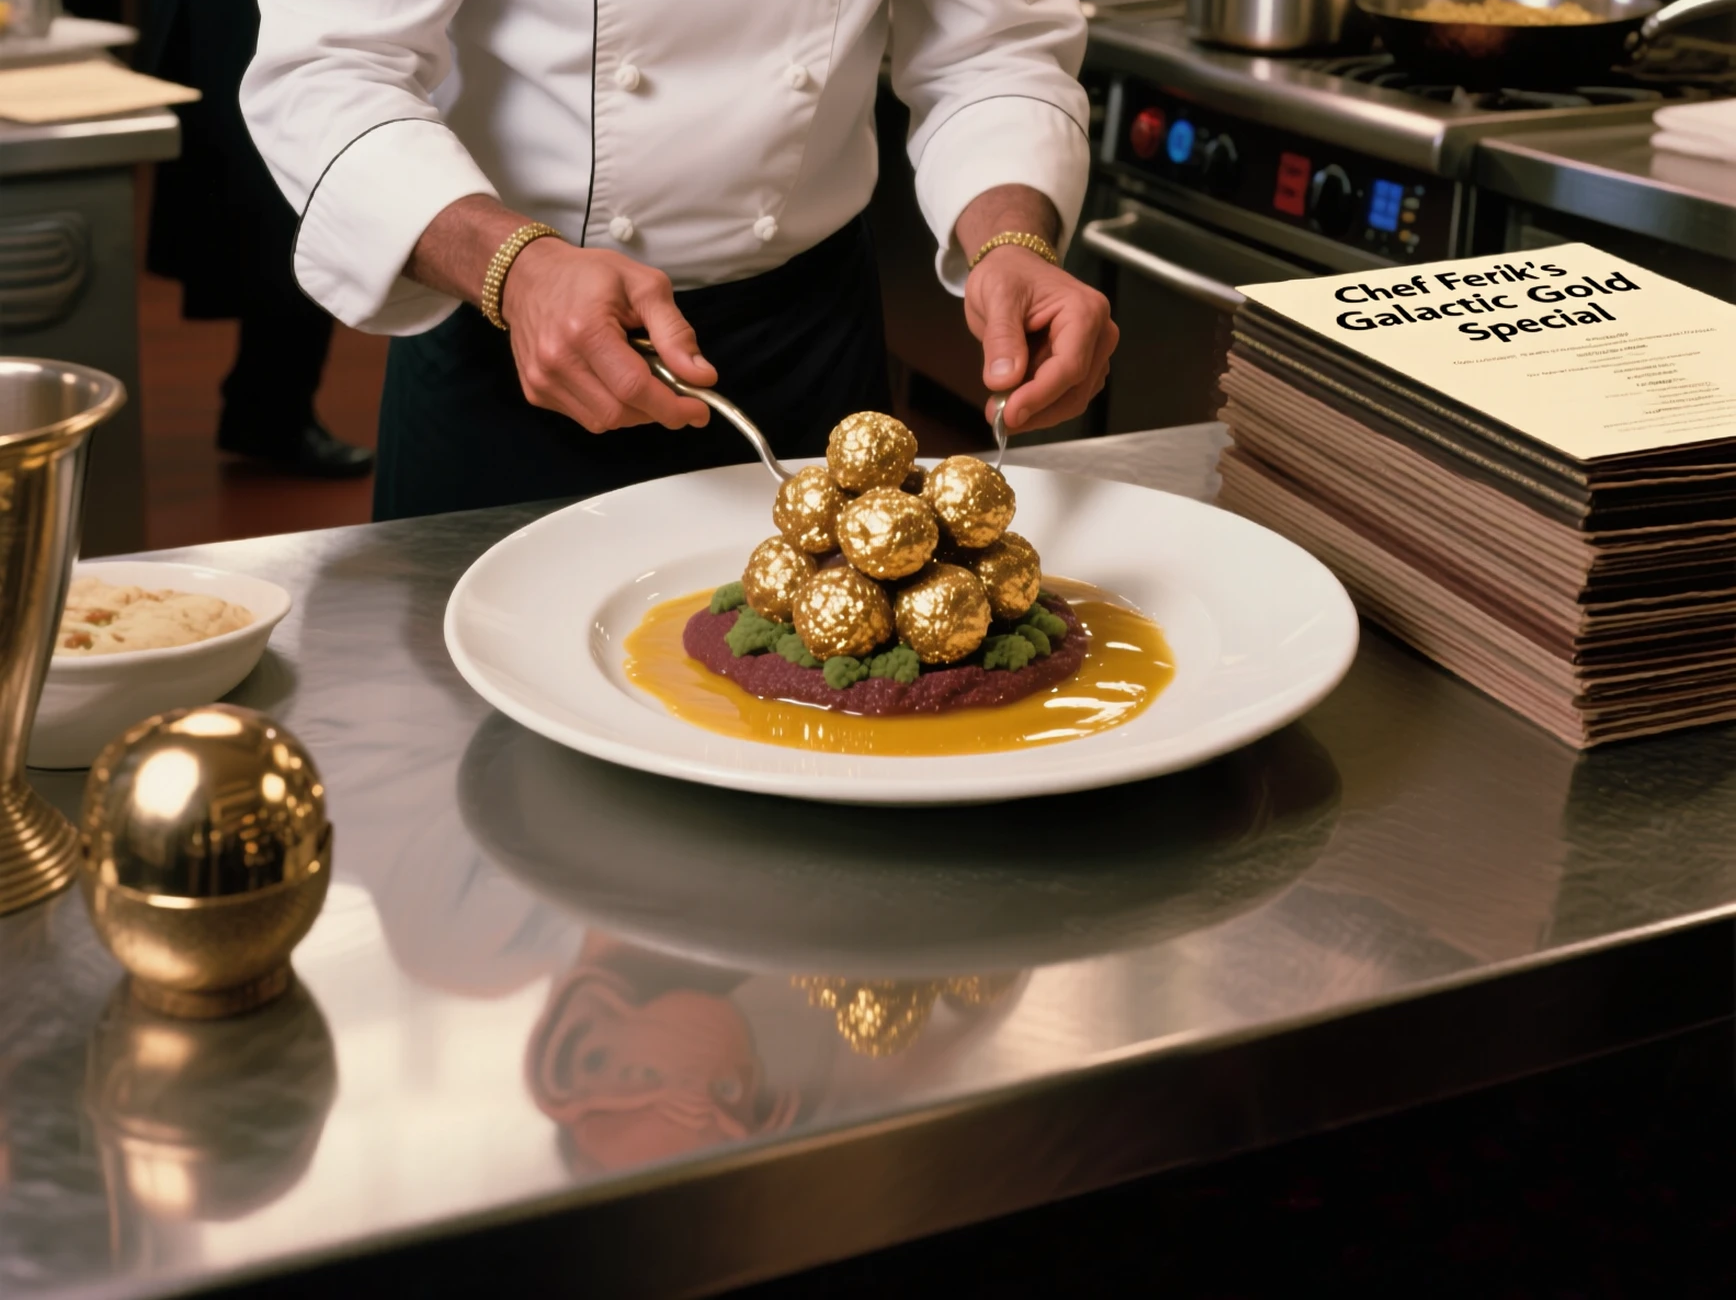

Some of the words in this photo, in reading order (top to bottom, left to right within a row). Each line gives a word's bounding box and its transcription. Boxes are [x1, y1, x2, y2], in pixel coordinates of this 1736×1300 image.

[1334, 275, 1431, 303] Chef
[1433, 261, 1568, 291] Ferik's
[1336, 293, 1518, 331] Galactic
[1526, 271, 1642, 303] Gold
[1458, 302, 1617, 343] Special
